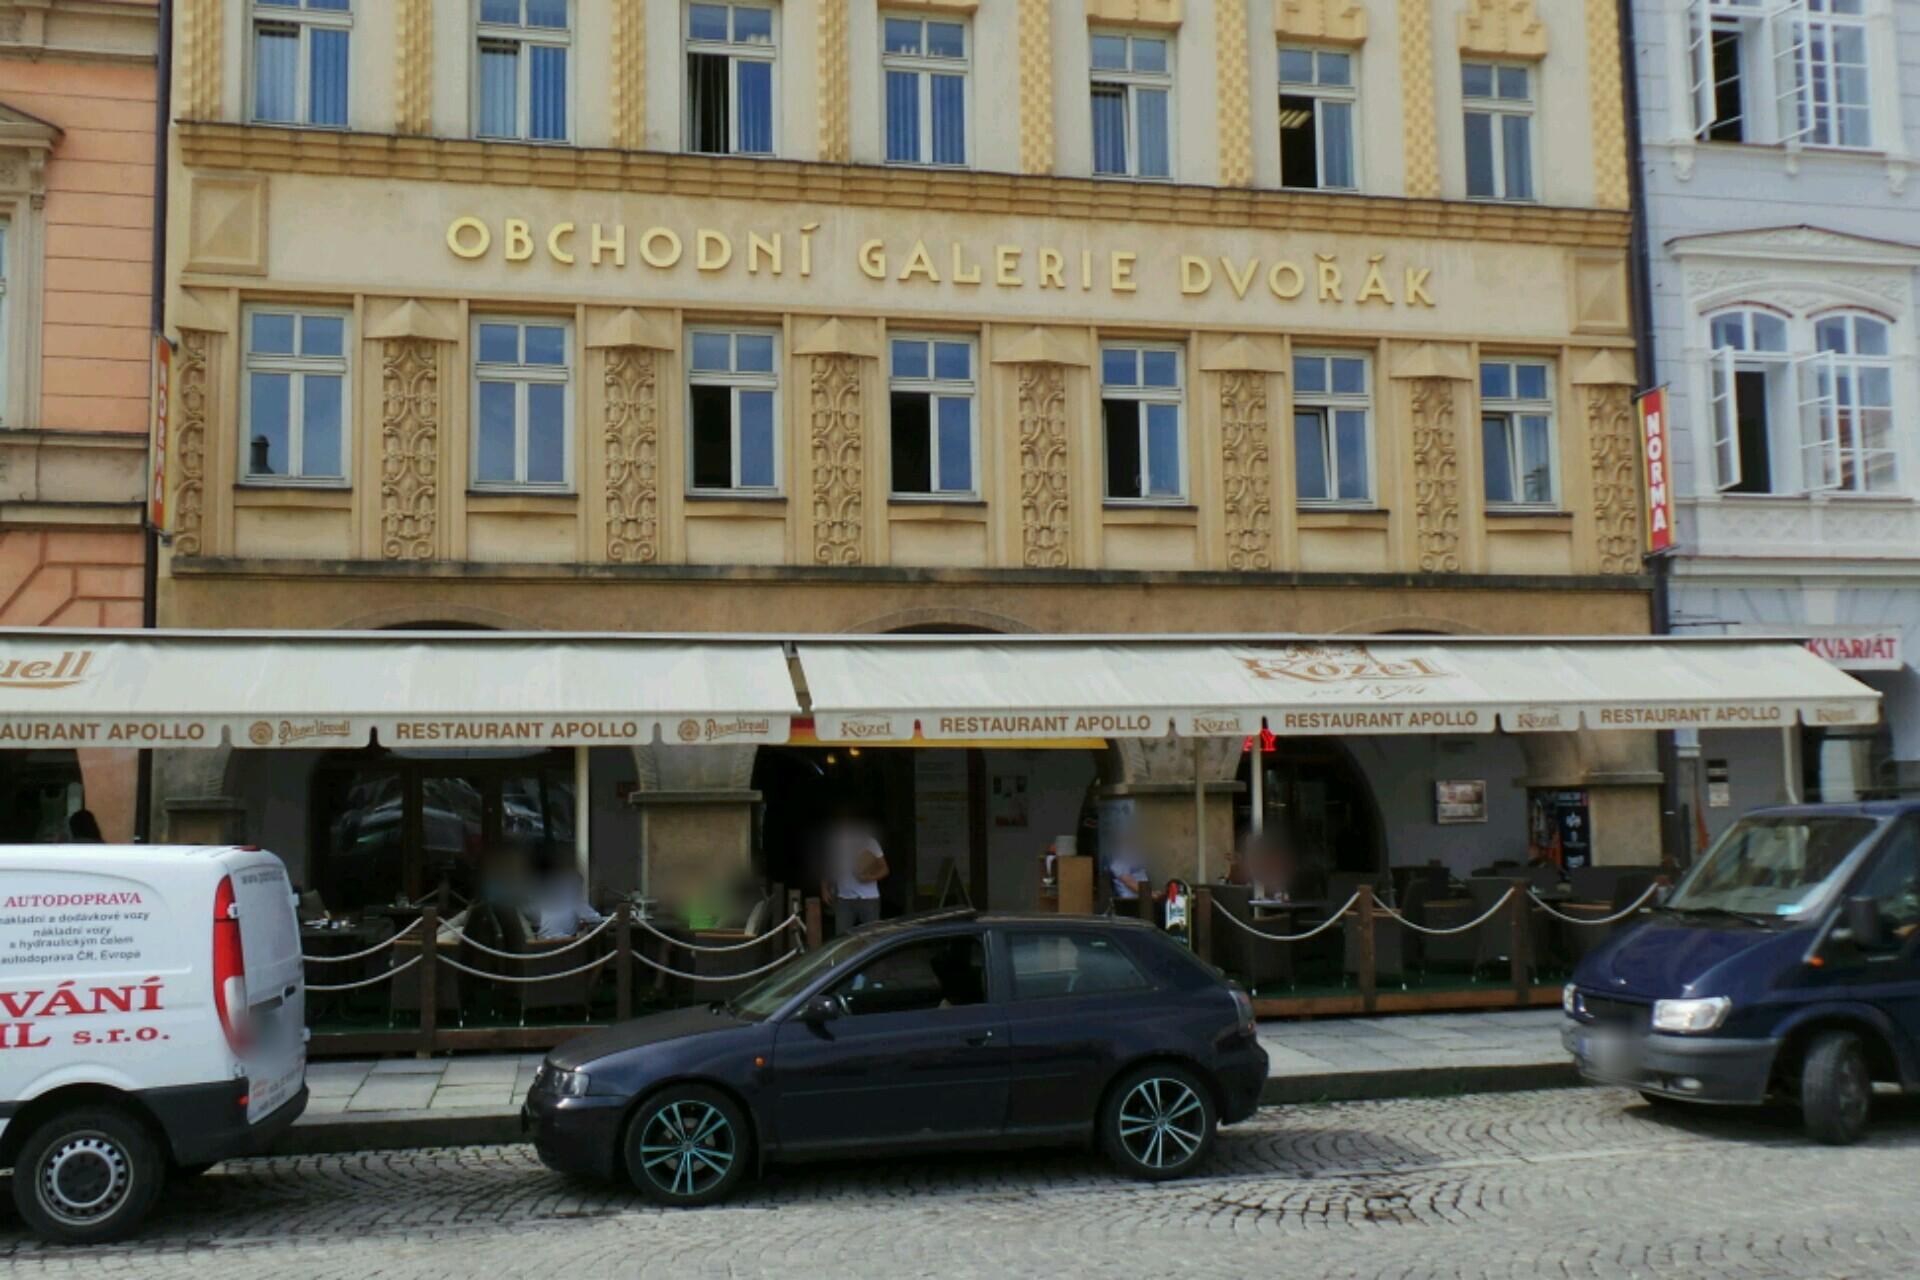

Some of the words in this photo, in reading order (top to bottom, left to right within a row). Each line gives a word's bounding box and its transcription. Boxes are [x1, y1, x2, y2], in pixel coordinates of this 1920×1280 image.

[446, 216, 820, 276] OBCHODNÍ
[858, 238, 1137, 292] GALERIE
[1180, 252, 1435, 306] DVOŘÁK
[1646, 411, 1668, 532] NORMA
[940, 715, 1072, 733] RESTAURANT
[1075, 714, 1151, 731] APOLLO
[1193, 716, 1241, 733] Kozel
[1284, 711, 1405, 729] RESTAURANT
[1407, 711, 1479, 727] APOLLO
[1600, 708, 1711, 724] RESTAURANT
[1715, 706, 1781, 722] APOLLO
[0, 722, 101, 741] AURANT
[107, 722, 205, 741] APOLLO
[396, 721, 544, 740] RESTAURANT
[551, 720, 638, 738] APOLLO
[841, 719, 891, 738] Kozel
[4, 892, 142, 908] AUTODOPRAVA
[0, 976, 165, 1018] VÁNÍ
[73, 1026, 171, 1044] s.r.o.
